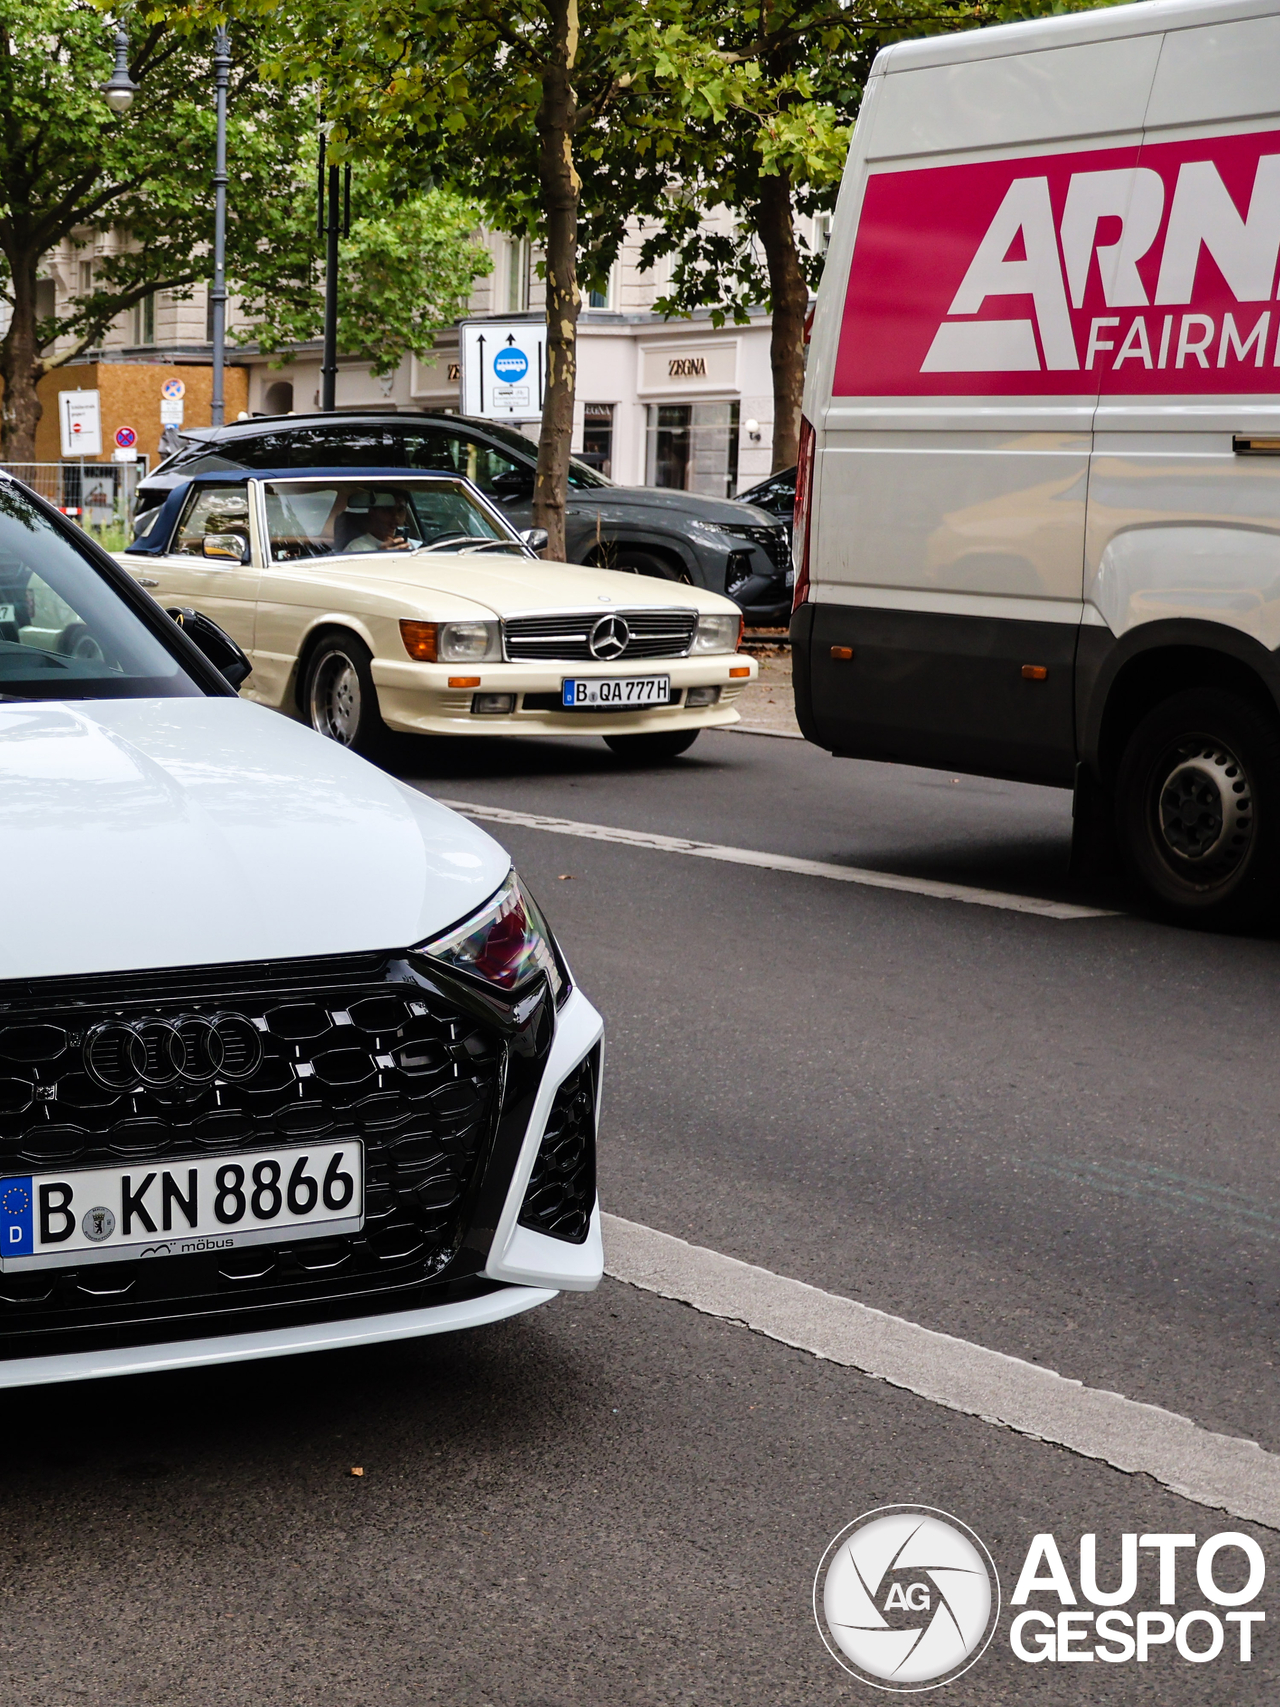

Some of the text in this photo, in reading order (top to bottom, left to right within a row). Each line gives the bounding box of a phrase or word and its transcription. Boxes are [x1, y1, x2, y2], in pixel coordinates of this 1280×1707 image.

[919, 153, 1280, 373] ARN
[1085, 311, 1280, 370] FAIRM
[668, 358, 706, 376] ZEGNA
[576, 683, 588, 702] B
[9, 1151, 355, 1245] D B KN 8866
[181, 1237, 235, 1252] möbus
